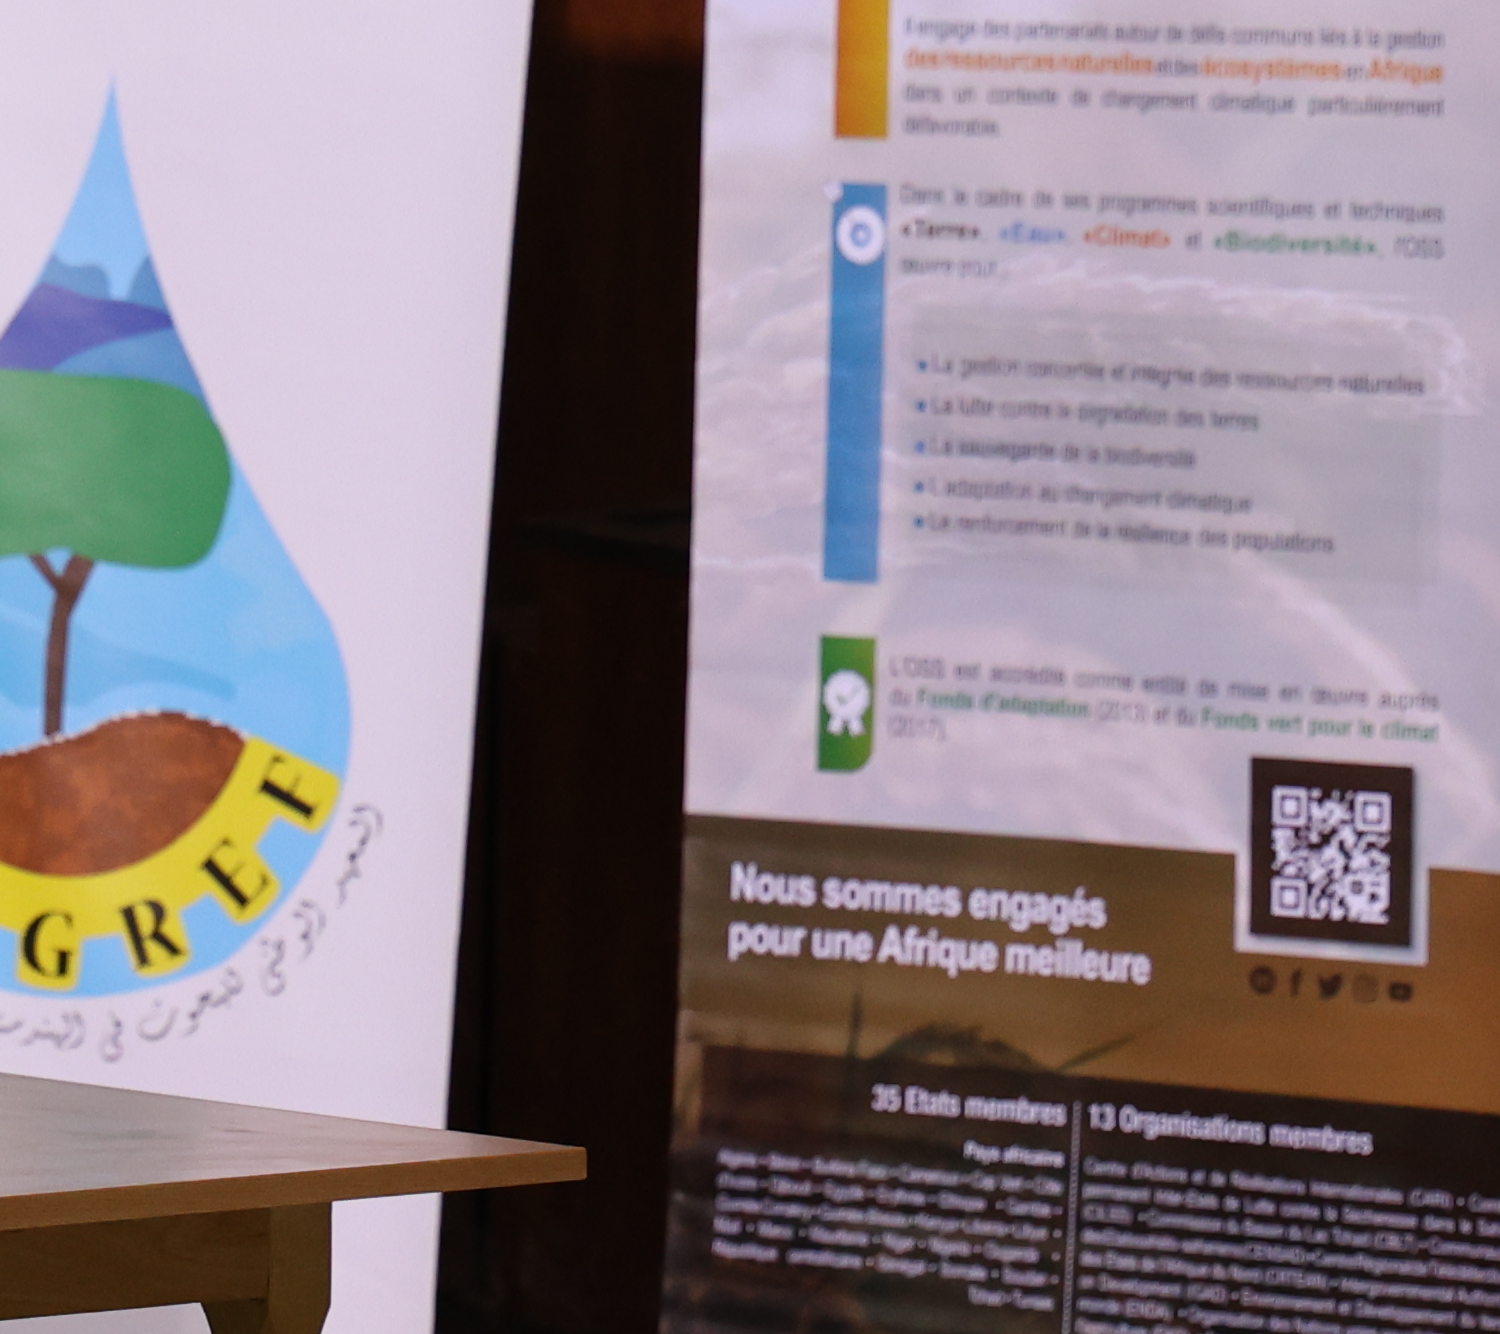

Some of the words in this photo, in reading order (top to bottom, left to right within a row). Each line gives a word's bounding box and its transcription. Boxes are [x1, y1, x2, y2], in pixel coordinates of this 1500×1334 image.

[730, 862, 816, 907] Nous
[821, 876, 963, 920] sommes
[968, 881, 1108, 930] engagés
[727, 922, 806, 962] pour
[810, 929, 874, 963] une
[875, 931, 999, 979] Afrique
[1003, 941, 1152, 986] meilleure
